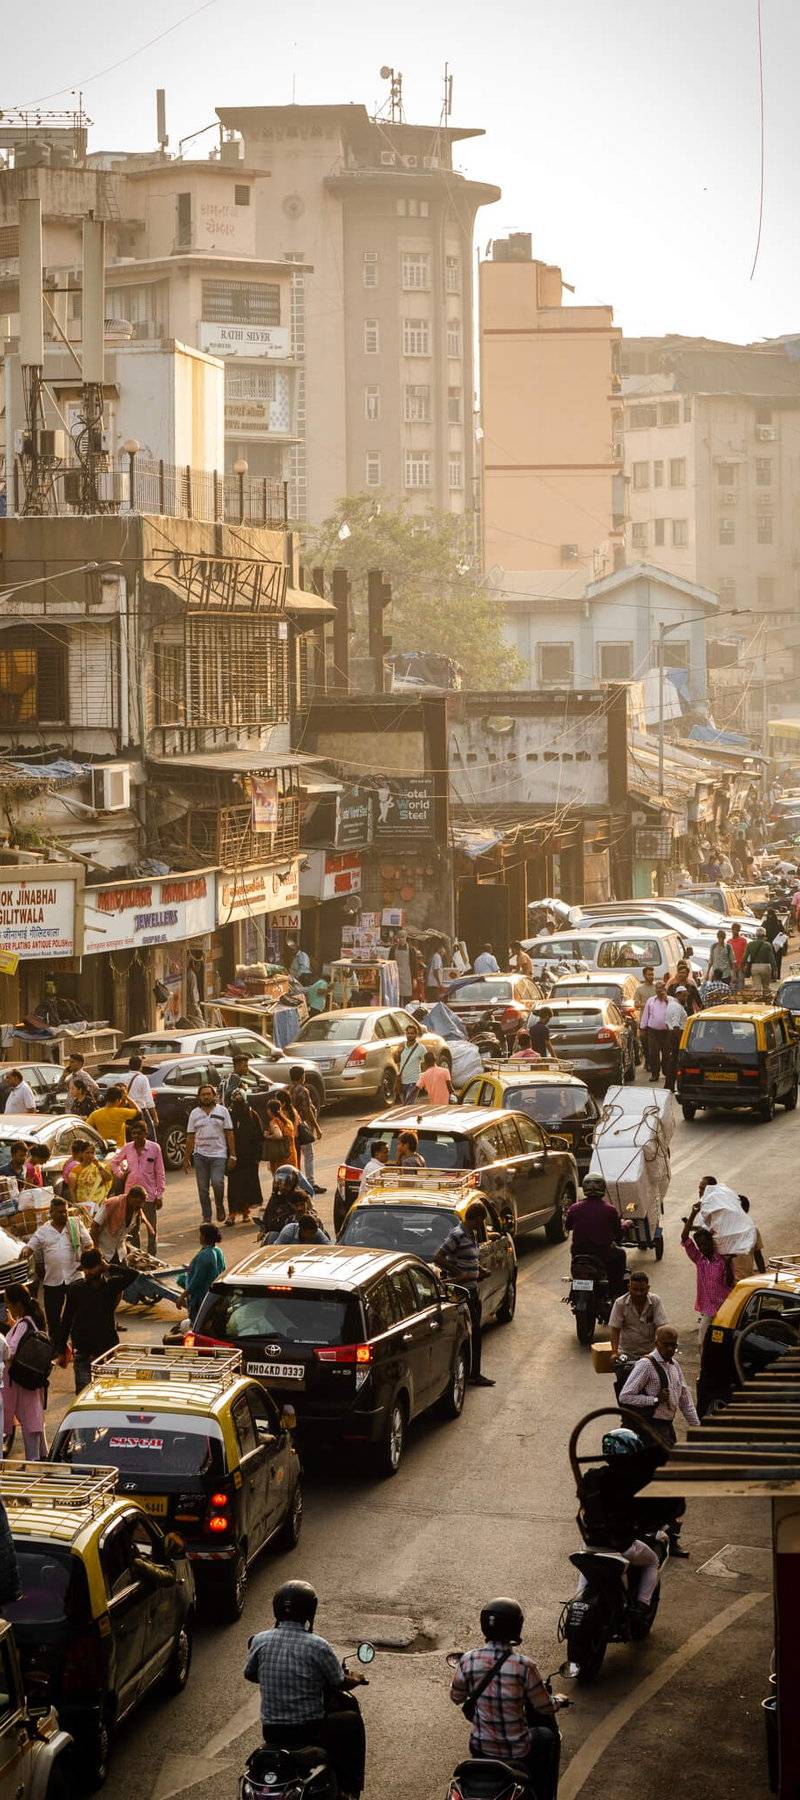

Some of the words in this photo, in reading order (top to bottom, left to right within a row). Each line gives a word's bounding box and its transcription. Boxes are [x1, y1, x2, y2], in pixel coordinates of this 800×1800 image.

[220, 330, 244, 340] RATHI
[246, 331, 271, 342] SILVER
[403, 789, 428, 799] otel
[397, 799, 430, 810] World
[400, 810, 427, 820] Steel
[16, 889, 57, 905] JINABHAI
[134, 910, 178, 933] JEWELLERS
[271, 915, 299, 926] ATM
[32, 940, 51, 949] ANTIQUE
[248, 1364, 280, 1375] MH04KD
[282, 1367, 304, 1377] 0333
